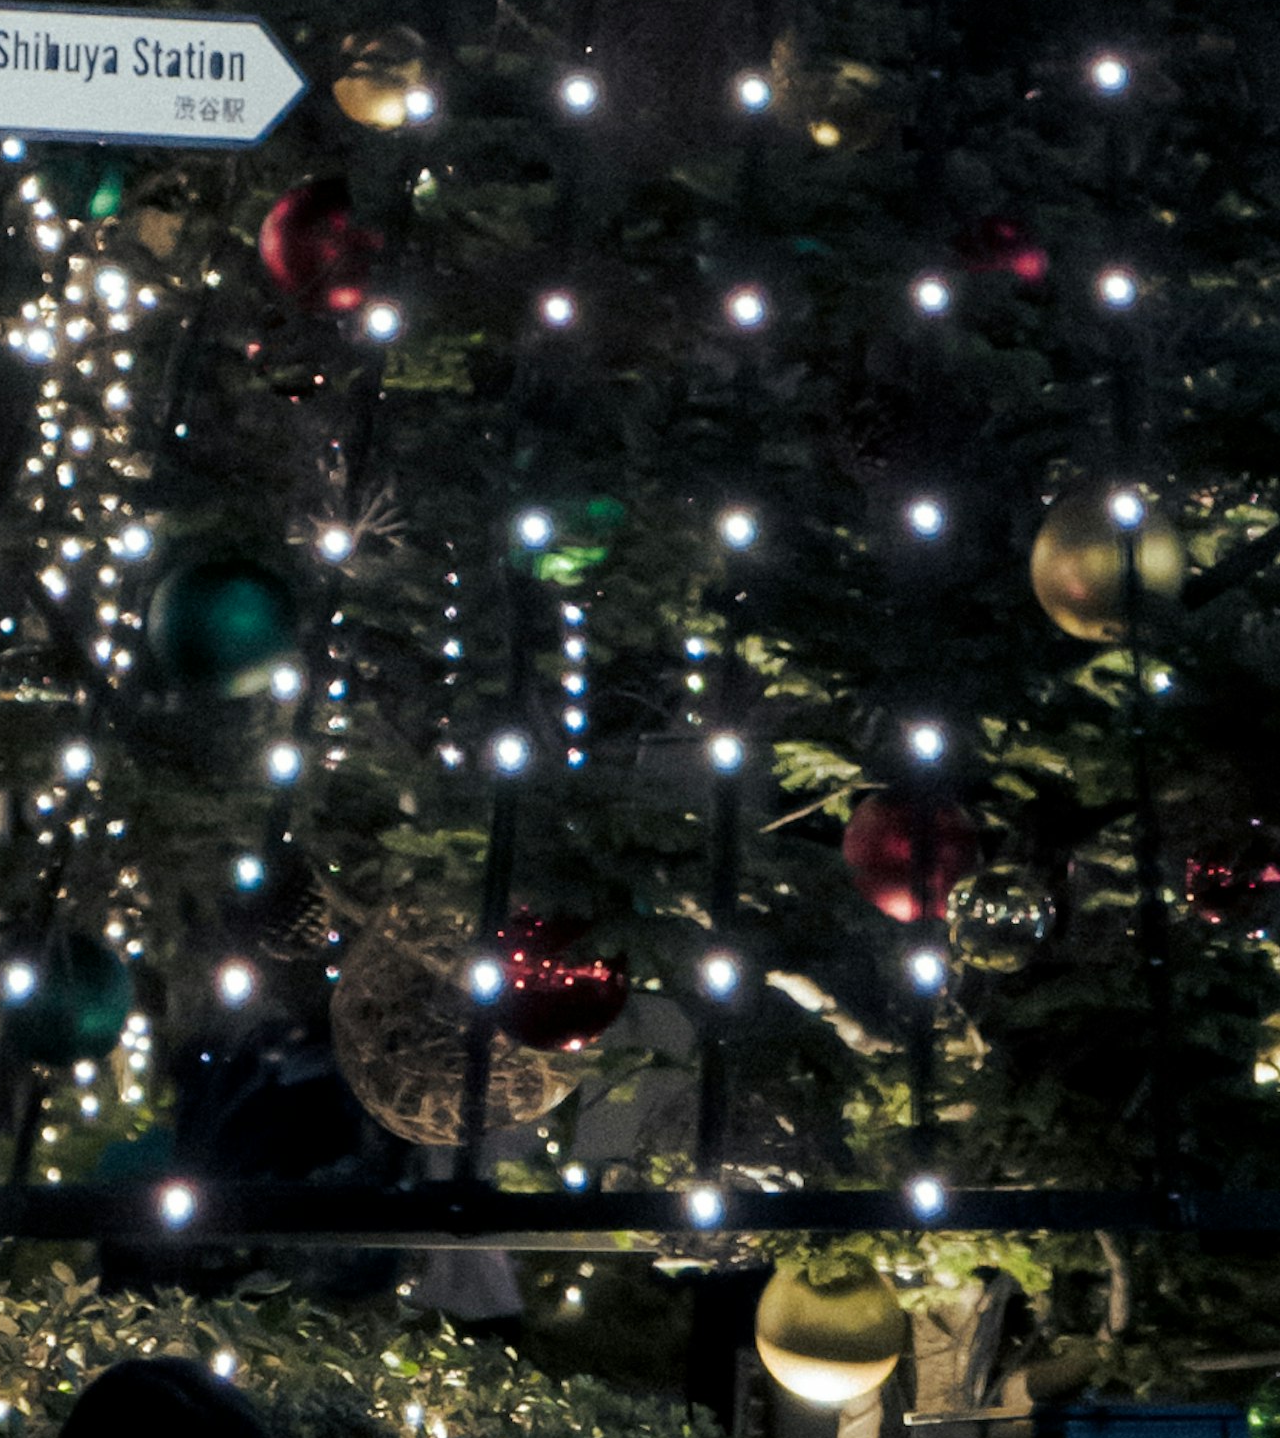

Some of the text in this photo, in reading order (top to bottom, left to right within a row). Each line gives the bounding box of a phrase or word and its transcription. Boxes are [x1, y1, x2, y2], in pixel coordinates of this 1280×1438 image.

[133, 37, 245, 82] Station
[174, 95, 245, 124] 渋谷駅
